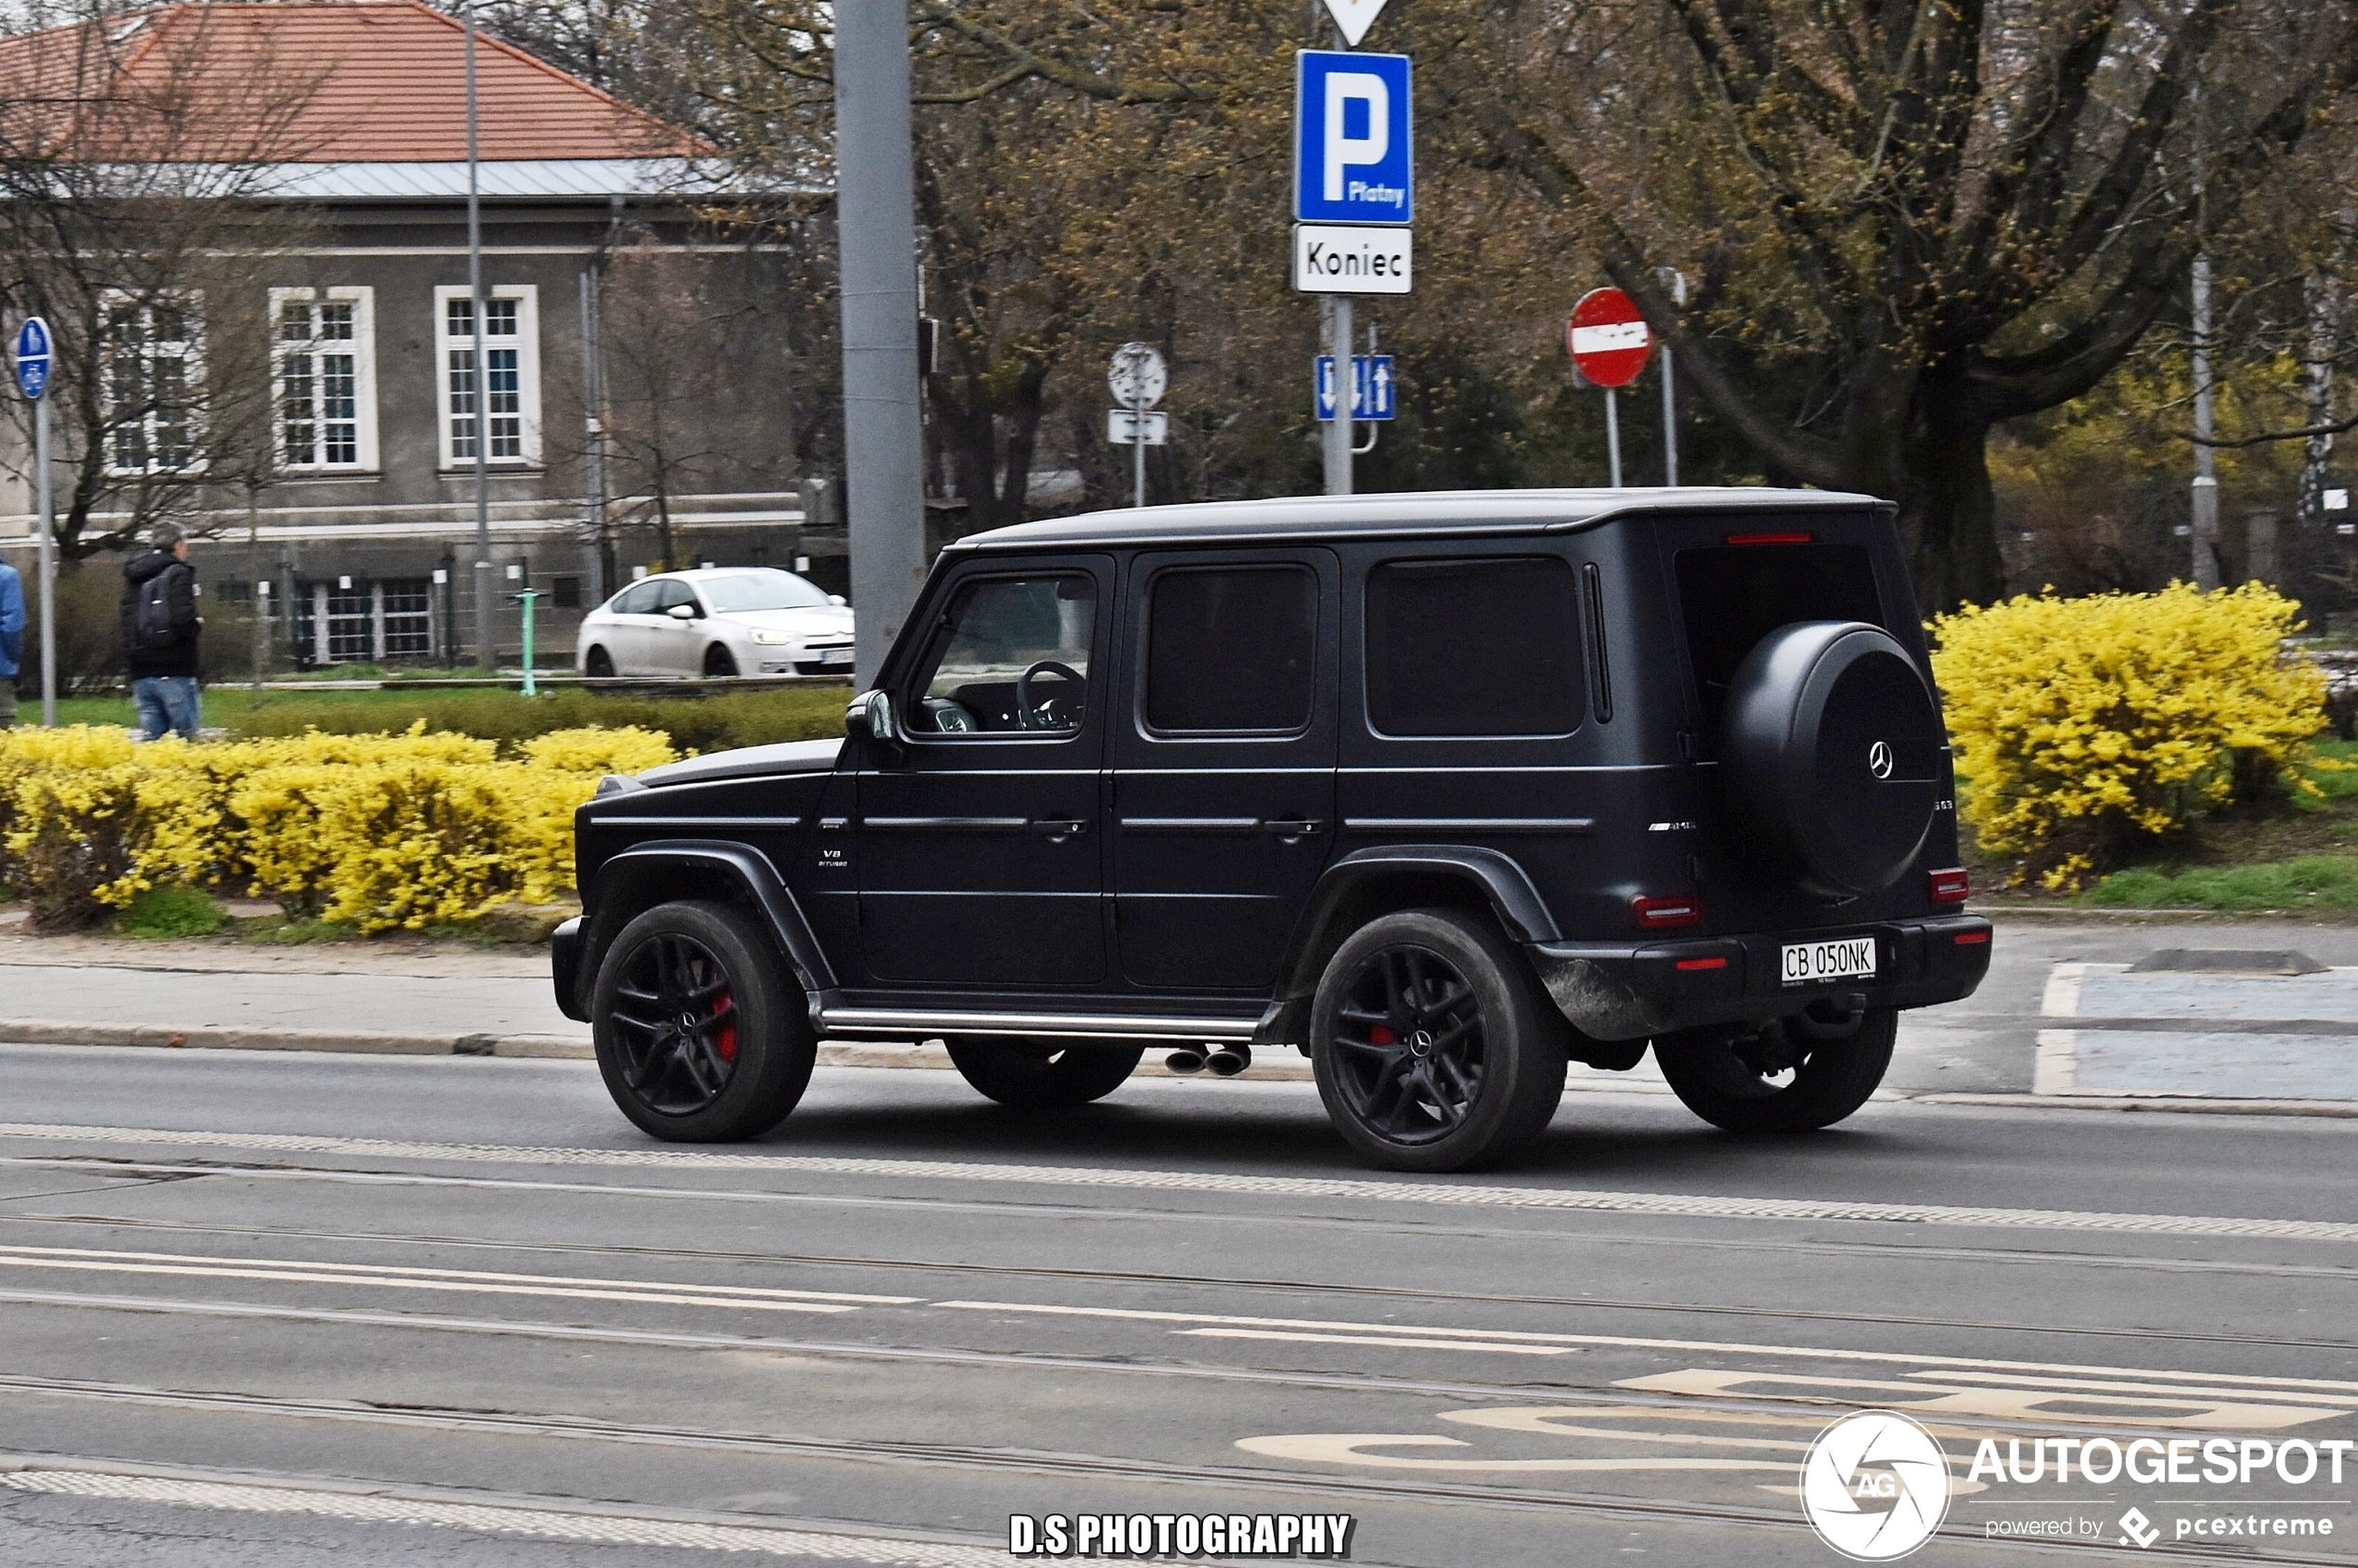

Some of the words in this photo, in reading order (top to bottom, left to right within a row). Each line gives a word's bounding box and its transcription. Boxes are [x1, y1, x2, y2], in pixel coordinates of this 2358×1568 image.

[1324, 71, 1389, 201] P
[1306, 241, 1402, 278] Koniec
[823, 849, 841, 858] V8
[1785, 947, 1809, 978] CB
[1816, 941, 1872, 975] 050NK
